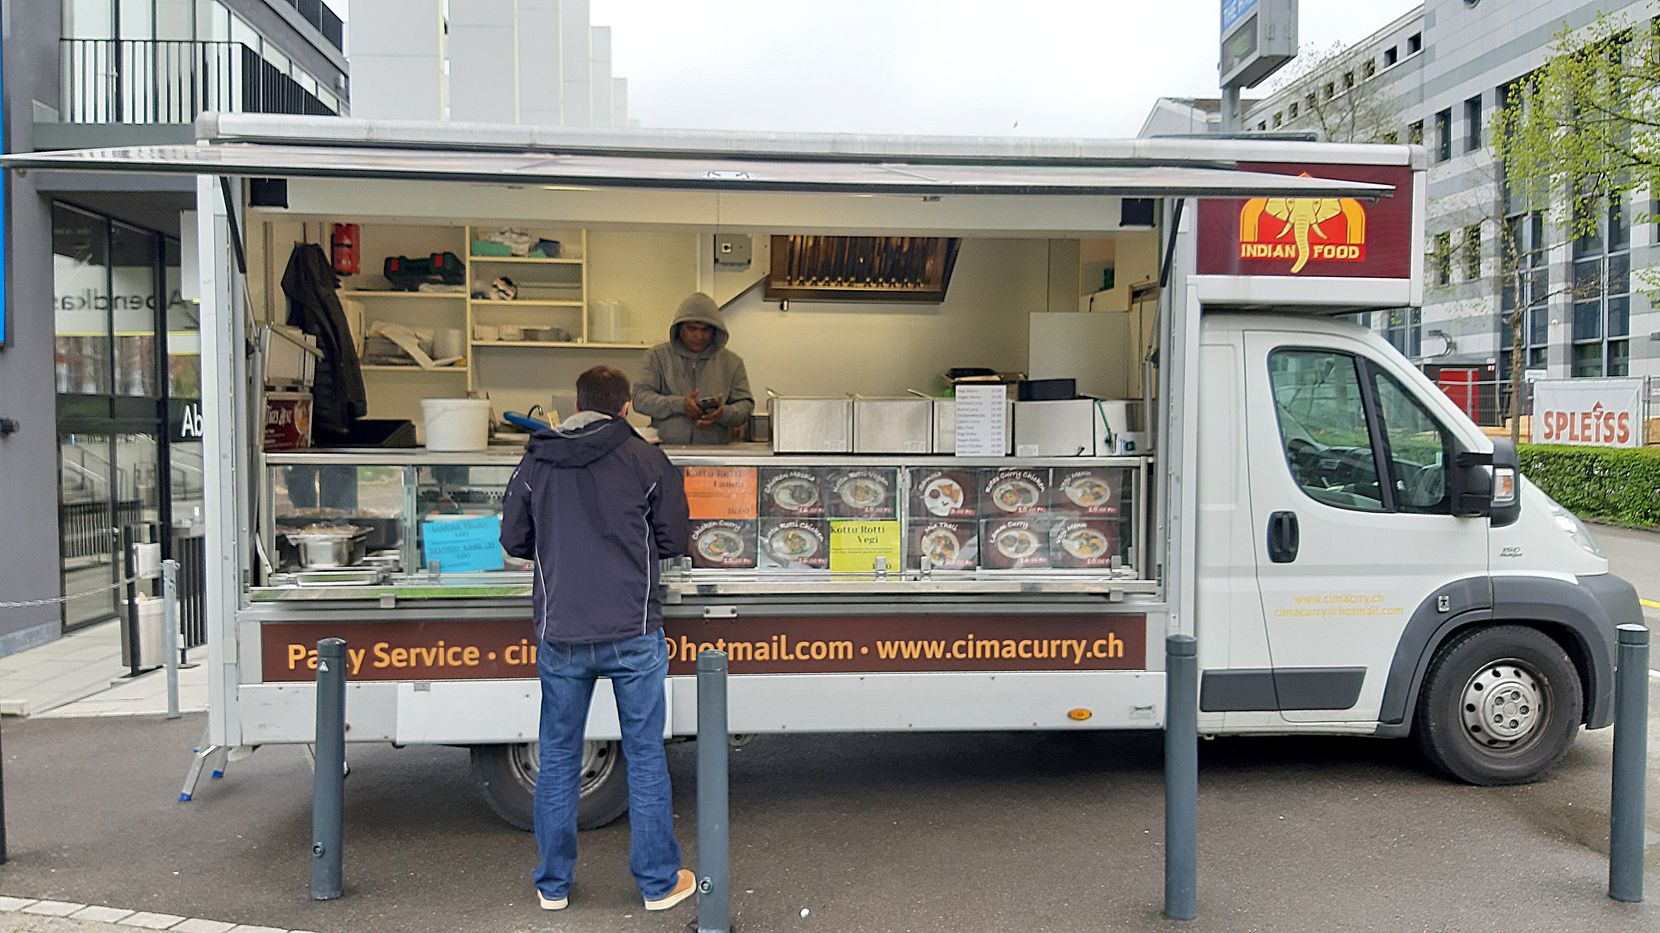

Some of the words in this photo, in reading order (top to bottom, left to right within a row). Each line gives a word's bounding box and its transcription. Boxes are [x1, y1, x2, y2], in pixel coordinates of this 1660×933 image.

[1240, 243, 1296, 258] INDIAN
[1313, 244, 1360, 259] FOOD
[860, 525, 885, 534] Rotti
[858, 536, 879, 545] Vegi
[287, 644, 366, 675] Pay
[372, 640, 480, 668] Service
[876, 632, 1124, 665] www.cimacurry.ch
